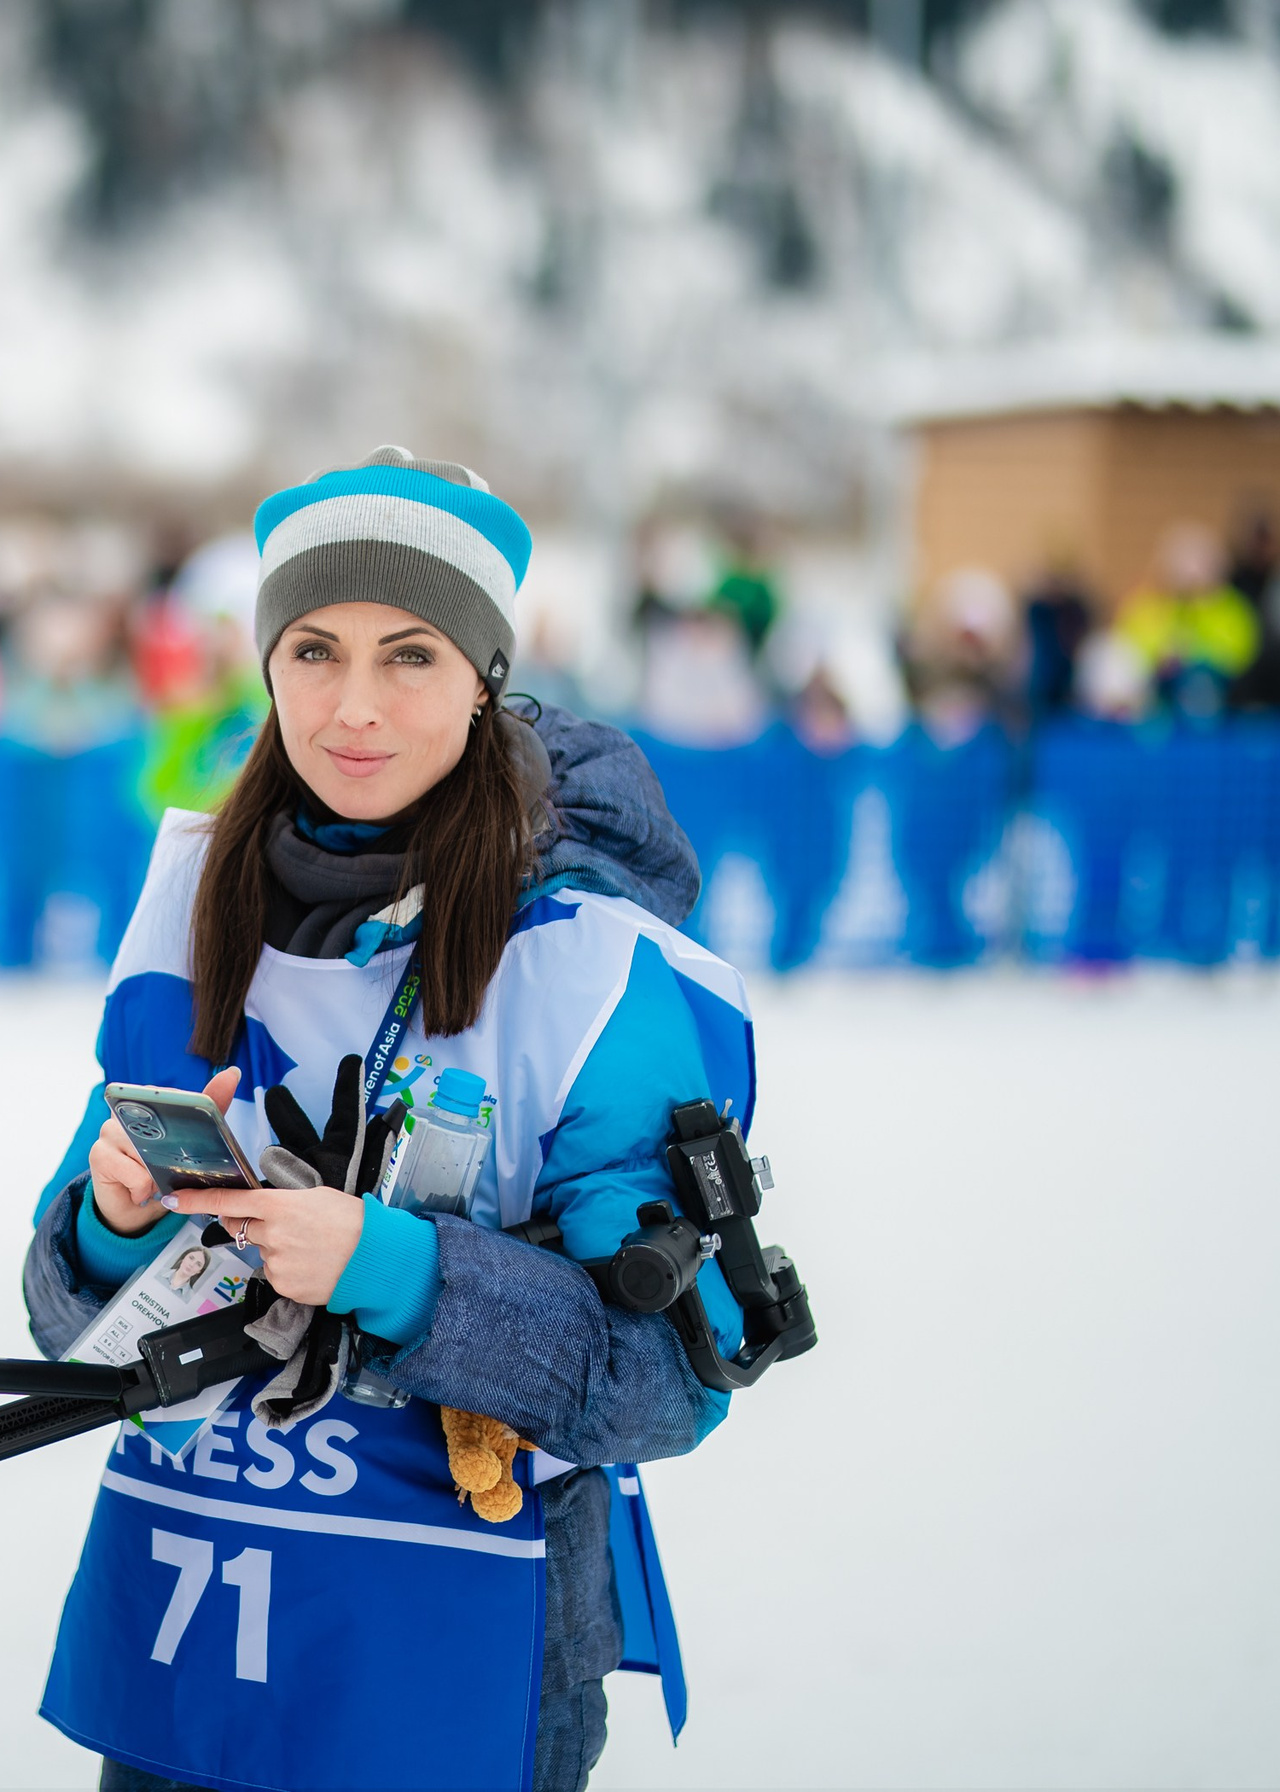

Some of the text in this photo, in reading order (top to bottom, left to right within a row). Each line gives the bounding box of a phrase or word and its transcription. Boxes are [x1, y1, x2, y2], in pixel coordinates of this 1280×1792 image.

[378, 1022, 401, 1055] Asia
[131, 1300, 168, 1329] OREKHOV
[138, 1290, 171, 1319] KRISTINA
[150, 1527, 273, 1683] 71
